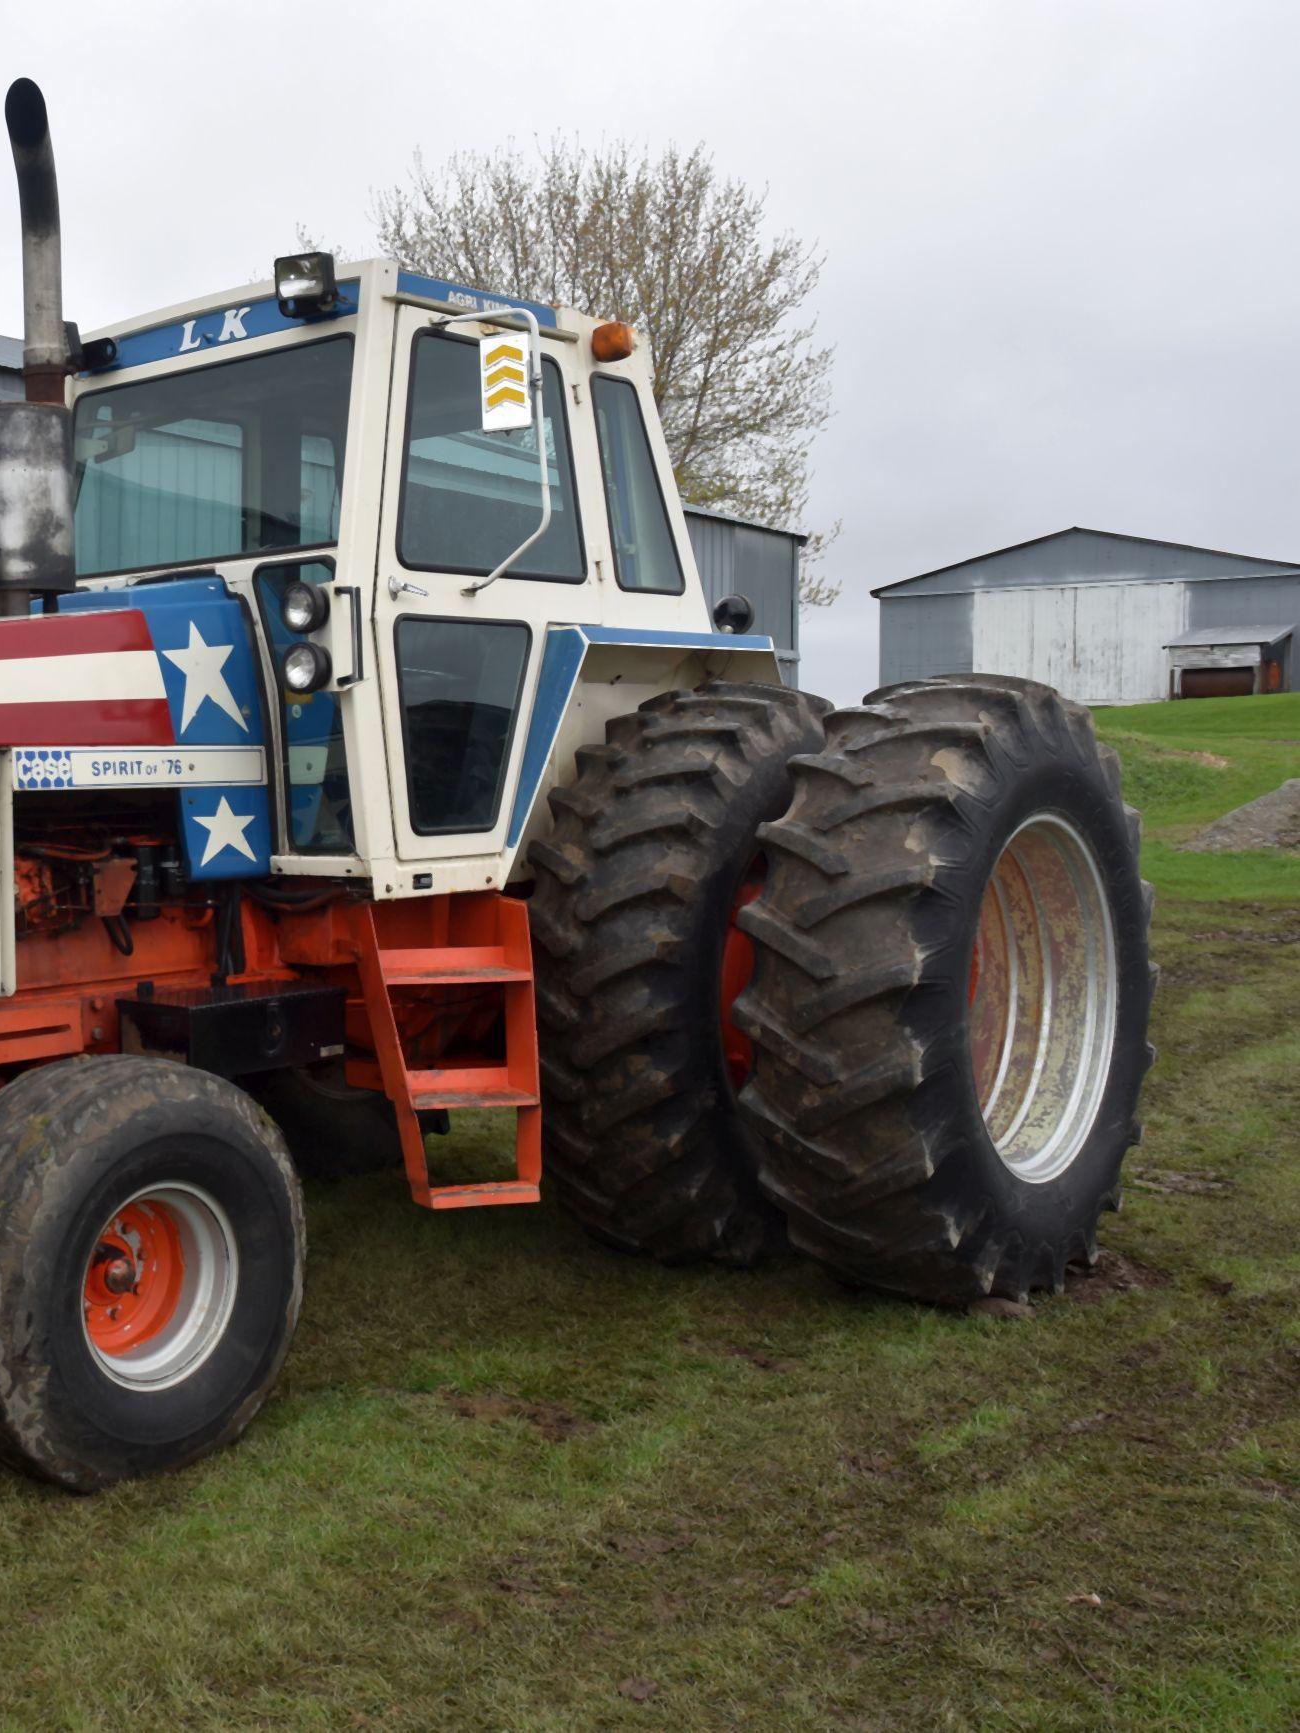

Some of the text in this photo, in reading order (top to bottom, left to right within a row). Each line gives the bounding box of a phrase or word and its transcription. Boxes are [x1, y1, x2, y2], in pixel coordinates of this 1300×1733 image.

[448, 290, 477, 309] AGRI
[179, 306, 251, 352] L K
[91, 760, 142, 777] SPIRIT
[162, 759, 182, 775] '76
